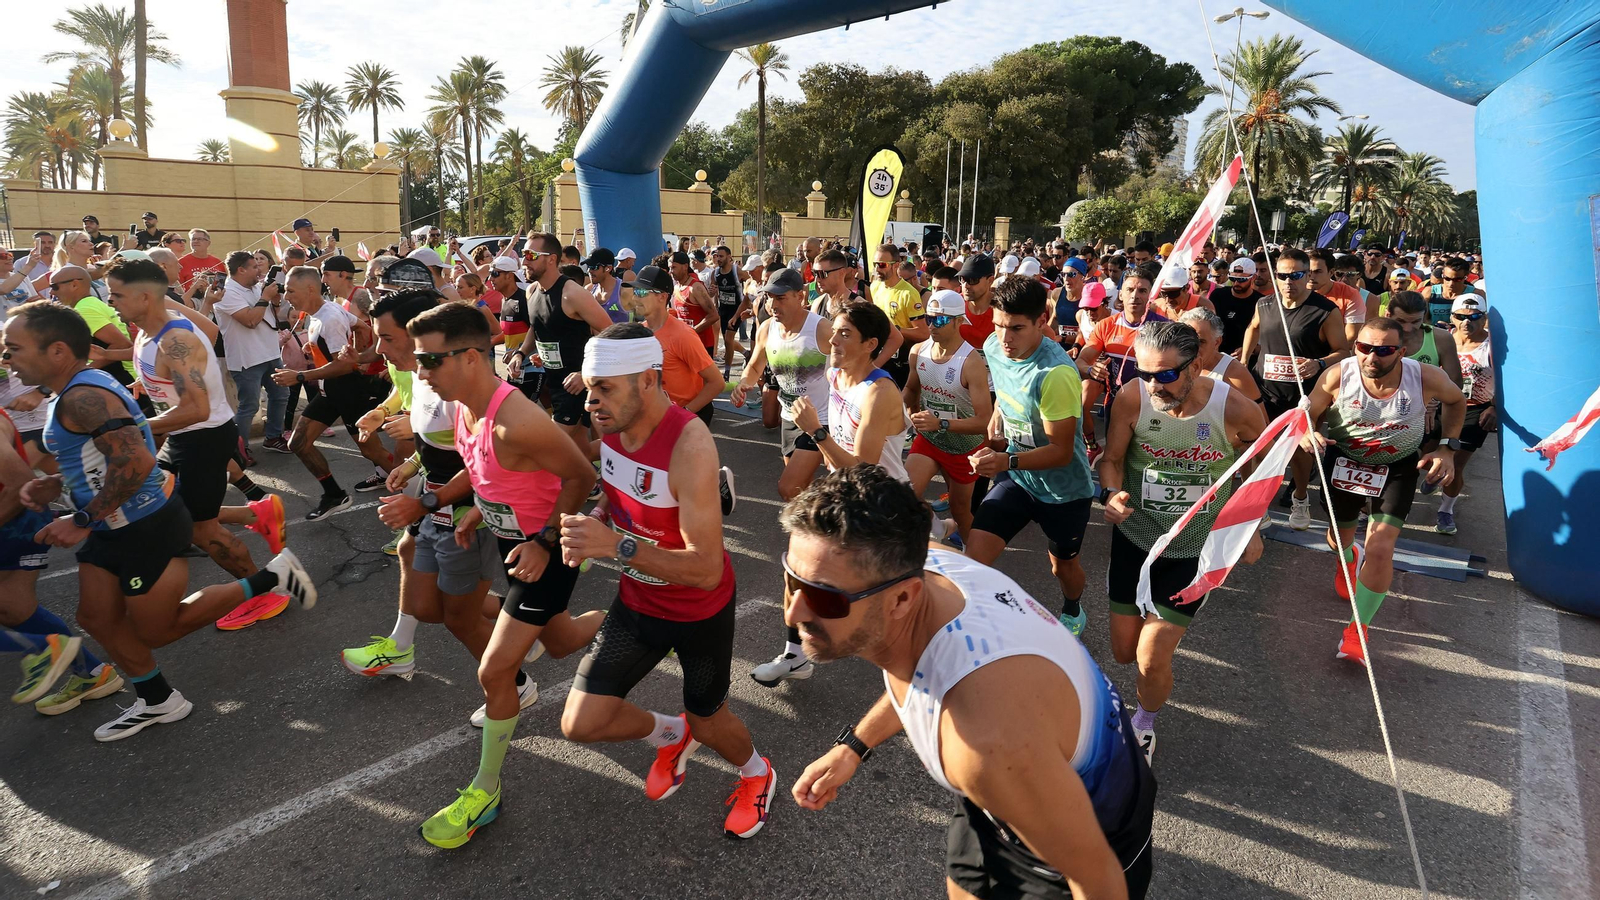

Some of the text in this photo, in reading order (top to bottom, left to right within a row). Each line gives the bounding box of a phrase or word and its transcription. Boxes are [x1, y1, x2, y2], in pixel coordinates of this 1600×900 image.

[876, 173, 887, 181] 1h
[1274, 364, 1293, 374] 538
[1140, 443, 1224, 462] maratón
[1153, 460, 1208, 472] JEREZ
[1346, 470, 1373, 485] 142
[1164, 487, 1187, 501] 32
